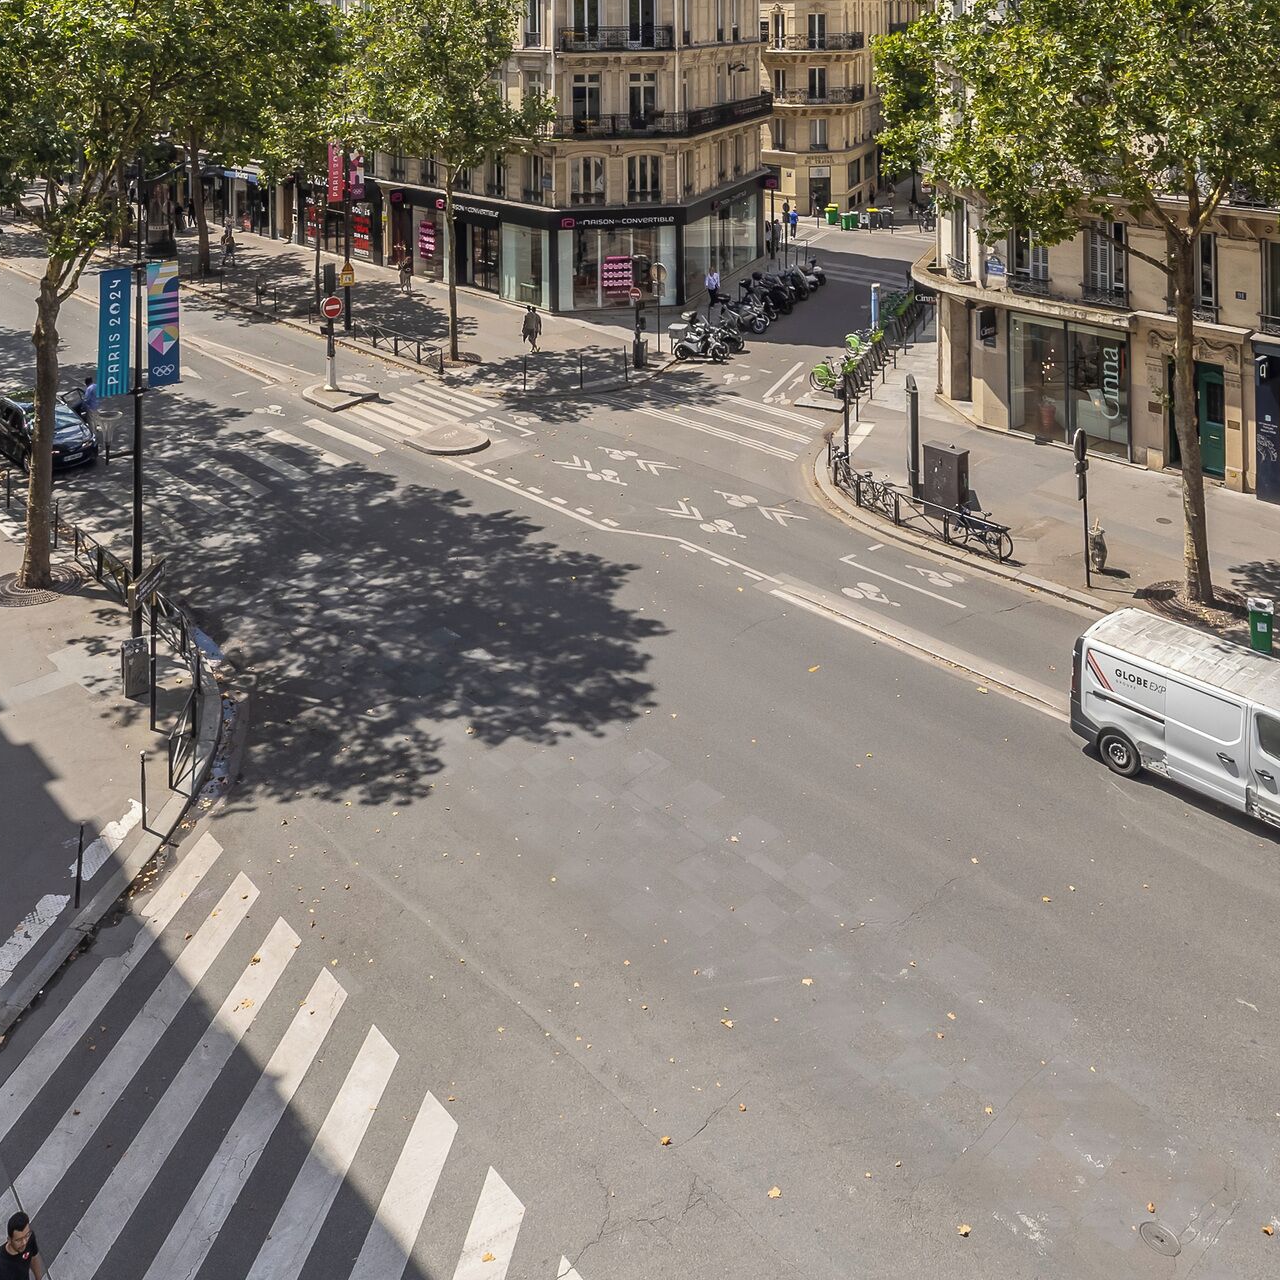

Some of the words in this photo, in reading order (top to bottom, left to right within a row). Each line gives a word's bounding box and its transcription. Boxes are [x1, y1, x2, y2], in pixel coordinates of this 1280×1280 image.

[622, 216, 675, 225] CONVERTIBLE
[108, 279, 122, 327] 2024
[914, 293, 936, 303] Cinn
[107, 333, 121, 386] PARIS
[1101, 346, 1120, 420] Cinna
[1114, 668, 1148, 689] GLOBE
